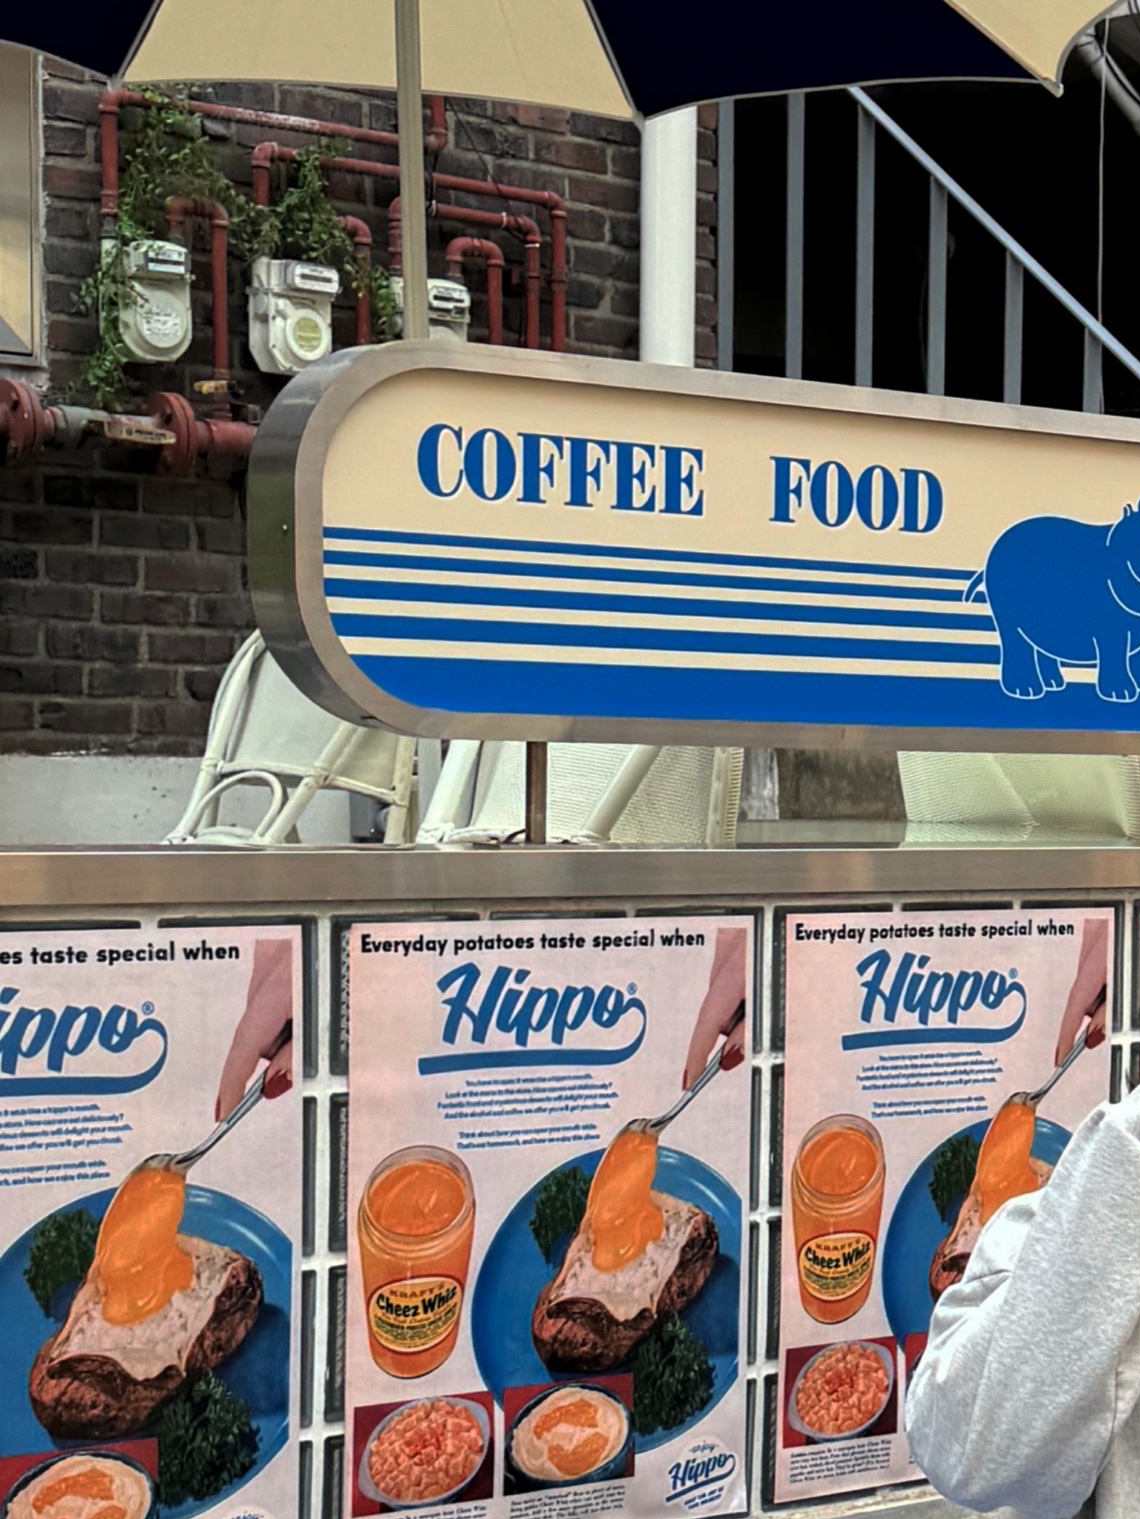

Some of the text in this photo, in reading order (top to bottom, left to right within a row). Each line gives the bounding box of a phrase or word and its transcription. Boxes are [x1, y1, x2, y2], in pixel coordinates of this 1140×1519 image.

[416, 423, 703, 517] COFFEE
[769, 456, 943, 533] FOOD
[361, 928, 705, 956] Everyday potatoes taste special when
[795, 919, 1074, 943] Everyday potatoes taste special when
[30, 941, 88, 965] taste
[97, 941, 175, 966] special
[183, 939, 240, 961] when
[856, 948, 1023, 1026] Hippo
[437, 961, 643, 1048] Hippo
[0, 986, 160, 1076] ippo
[805, 1246, 841, 1269] Cheez
[376, 1293, 421, 1317] Cheez
[668, 1454, 735, 1491] Hippo
